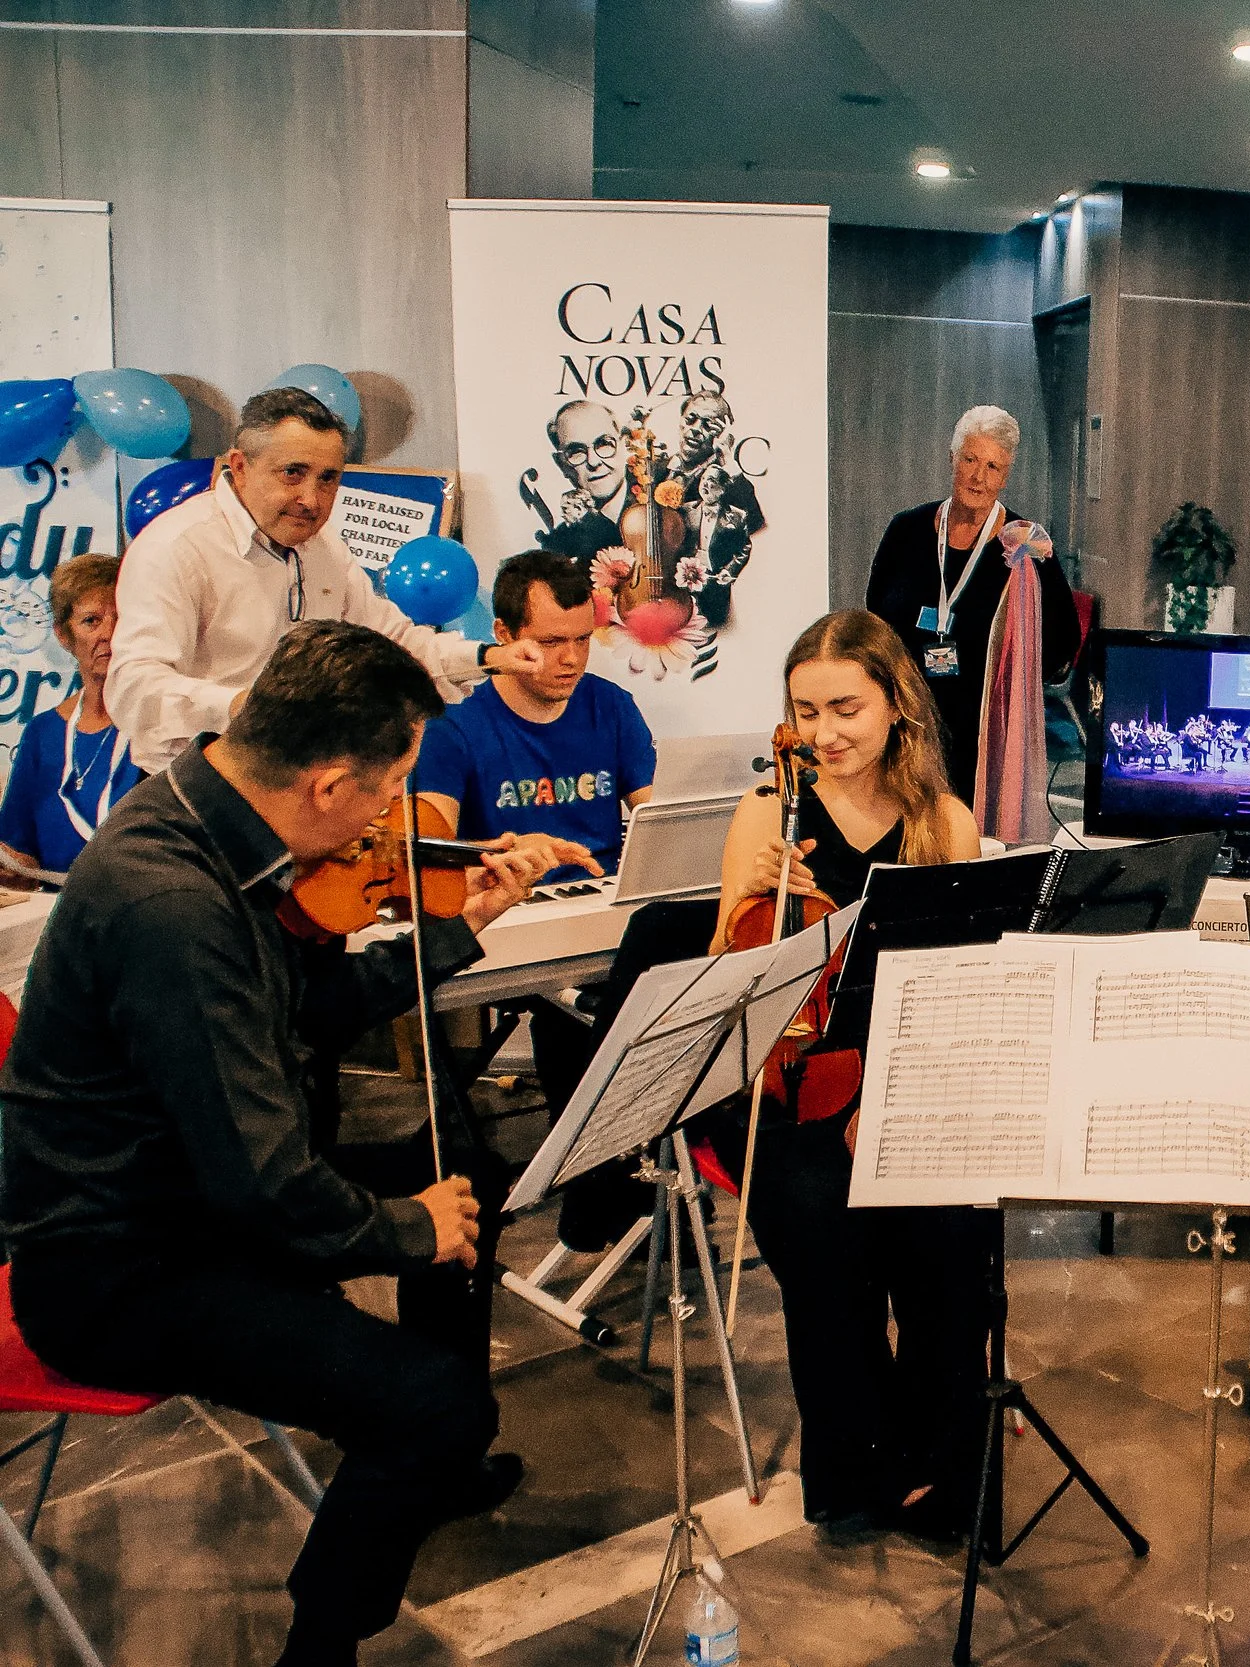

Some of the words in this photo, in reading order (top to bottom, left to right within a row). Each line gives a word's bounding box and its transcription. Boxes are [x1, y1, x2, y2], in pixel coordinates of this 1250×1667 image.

[557, 282, 727, 345] CASA
[554, 354, 726, 398] NOVAS
[341, 496, 376, 510] HAVE
[377, 503, 424, 520] RAISED
[344, 512, 369, 526] FOR
[371, 518, 411, 535] LOCAL
[364, 550, 389, 563] FAR
[1191, 921, 1248, 933] CONCIERTO
